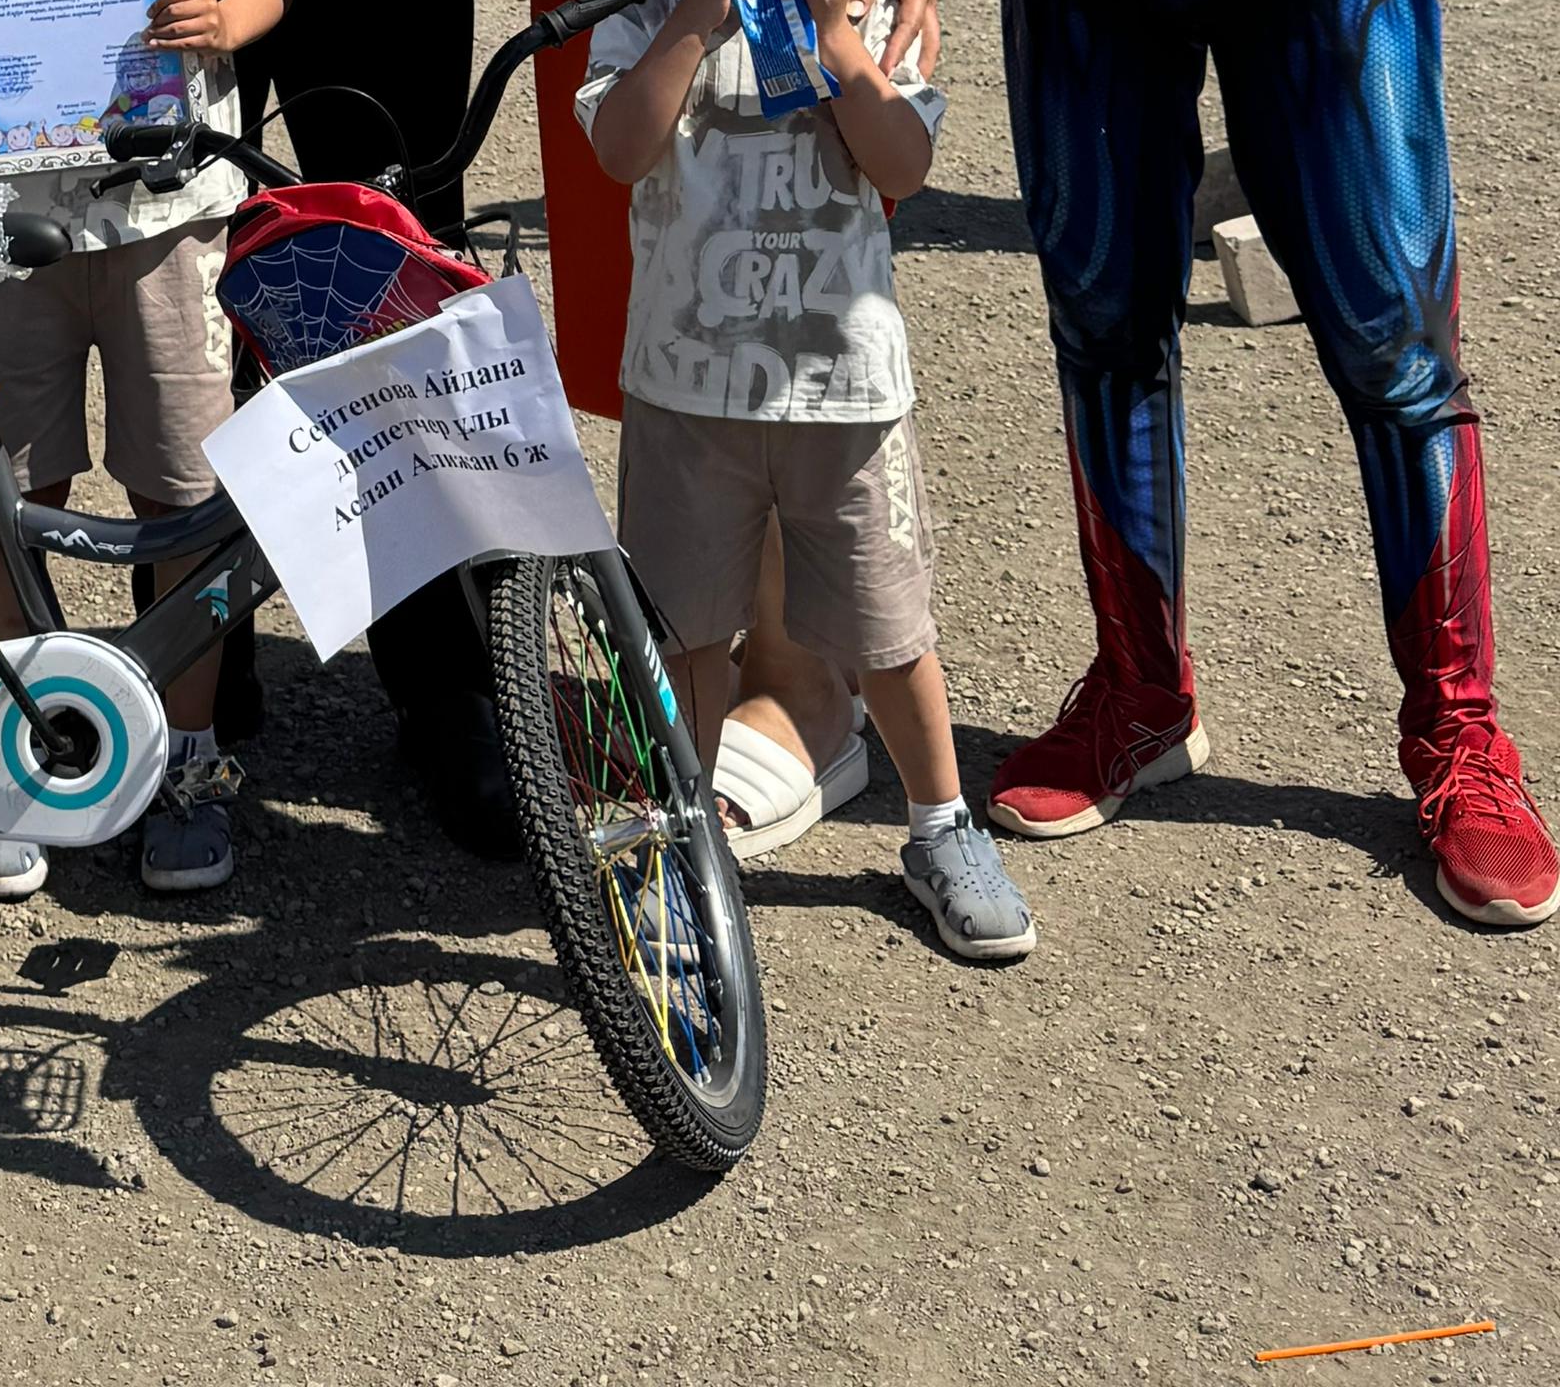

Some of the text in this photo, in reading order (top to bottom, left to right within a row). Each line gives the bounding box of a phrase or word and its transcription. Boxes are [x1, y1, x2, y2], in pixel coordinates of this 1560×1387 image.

[753, 231, 804, 250] YOUR
[288, 358, 526, 454] Сейтенова Айдана
[333, 418, 450, 482] диспетчер
[334, 442, 550, 531] Аслан Алижан 6 ж
